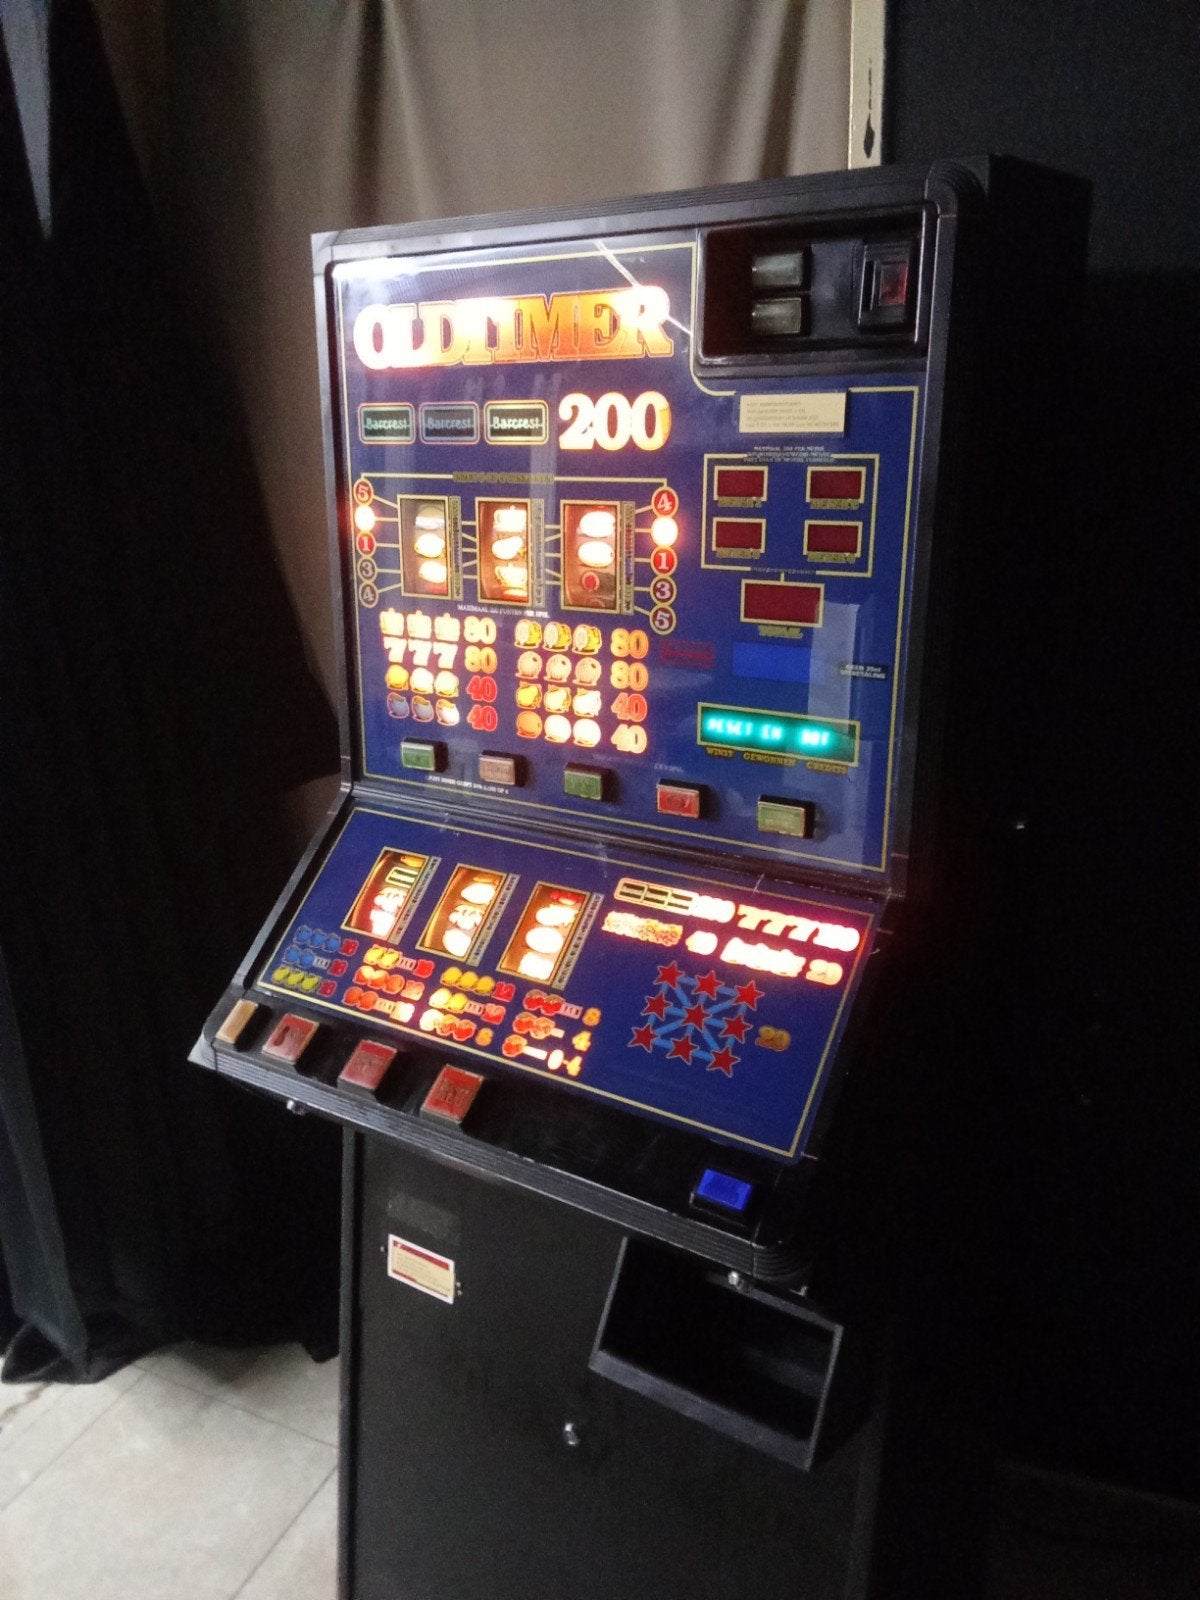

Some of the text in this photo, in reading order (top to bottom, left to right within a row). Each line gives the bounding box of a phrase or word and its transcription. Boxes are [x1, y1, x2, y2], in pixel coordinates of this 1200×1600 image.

[353, 286, 674, 370] OLDTIMER
[366, 417, 407, 430] Barcrest
[427, 416, 471, 430] Barcrest
[492, 415, 540, 430] Barcrest
[558, 391, 671, 450] 200
[358, 482, 370, 502] 5
[657, 492, 672, 512] 4
[360, 536, 371, 552] 1
[361, 561, 373, 577] 3
[658, 551, 669, 570] 1
[363, 586, 375, 602] 4
[655, 580, 671, 599] 3
[655, 609, 670, 630] 5
[463, 615, 497, 645] 80
[611, 627, 649, 660] 80
[464, 646, 498, 674] 80
[611, 660, 649, 691] 80
[466, 675, 498, 703] 40
[611, 692, 648, 722] 40
[467, 704, 498, 732] 40
[611, 724, 648, 753] 40
[706, 747, 735, 758] WINST
[743, 752, 797, 767] GEWONNEN
